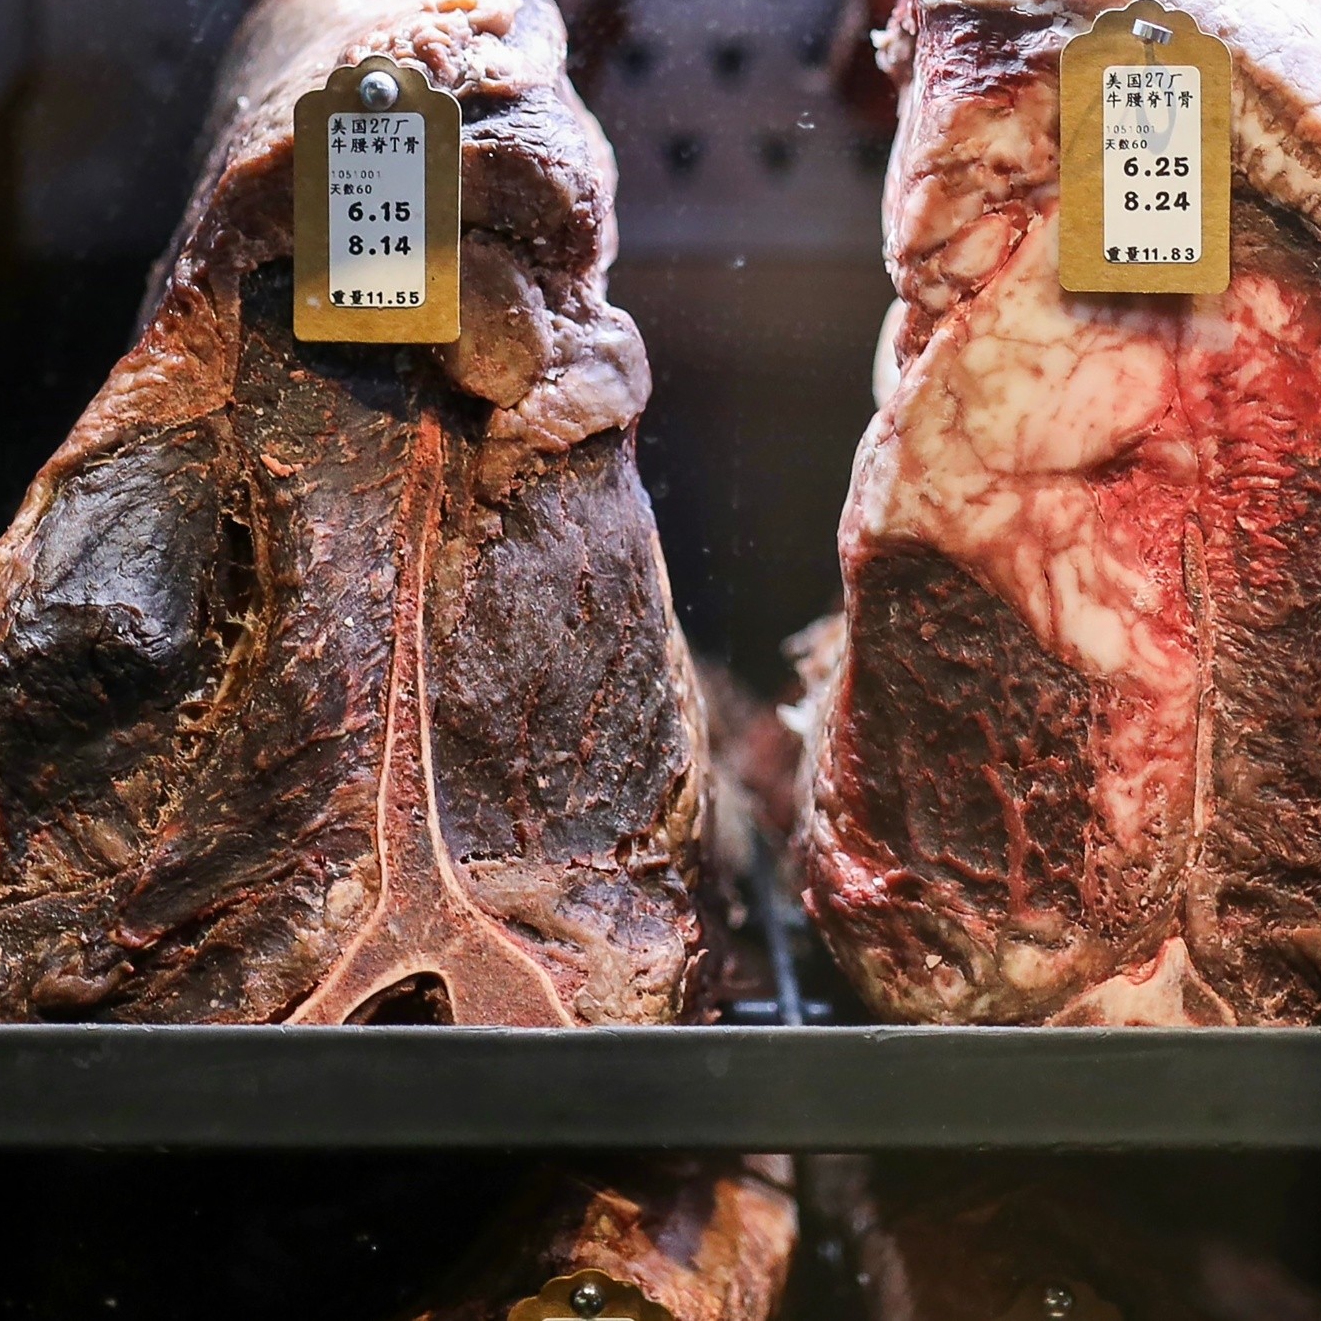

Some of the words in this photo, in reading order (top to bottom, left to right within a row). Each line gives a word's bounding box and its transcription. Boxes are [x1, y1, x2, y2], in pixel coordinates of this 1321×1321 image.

[1105, 72, 1183, 90] 美国27厂
[1106, 90, 1194, 109] 牛腰脊T骨
[331, 118, 410, 136] 美国27厂
[331, 136, 420, 155] 牛腰脊T骨
[1123, 156, 1190, 177] 6.25
[1123, 191, 1191, 211] 8.24
[348, 201, 411, 223] 6.15
[348, 235, 411, 256] 8.14
[1105, 247, 1195, 262] 重量11.83
[331, 290, 420, 306] 重量11.55
